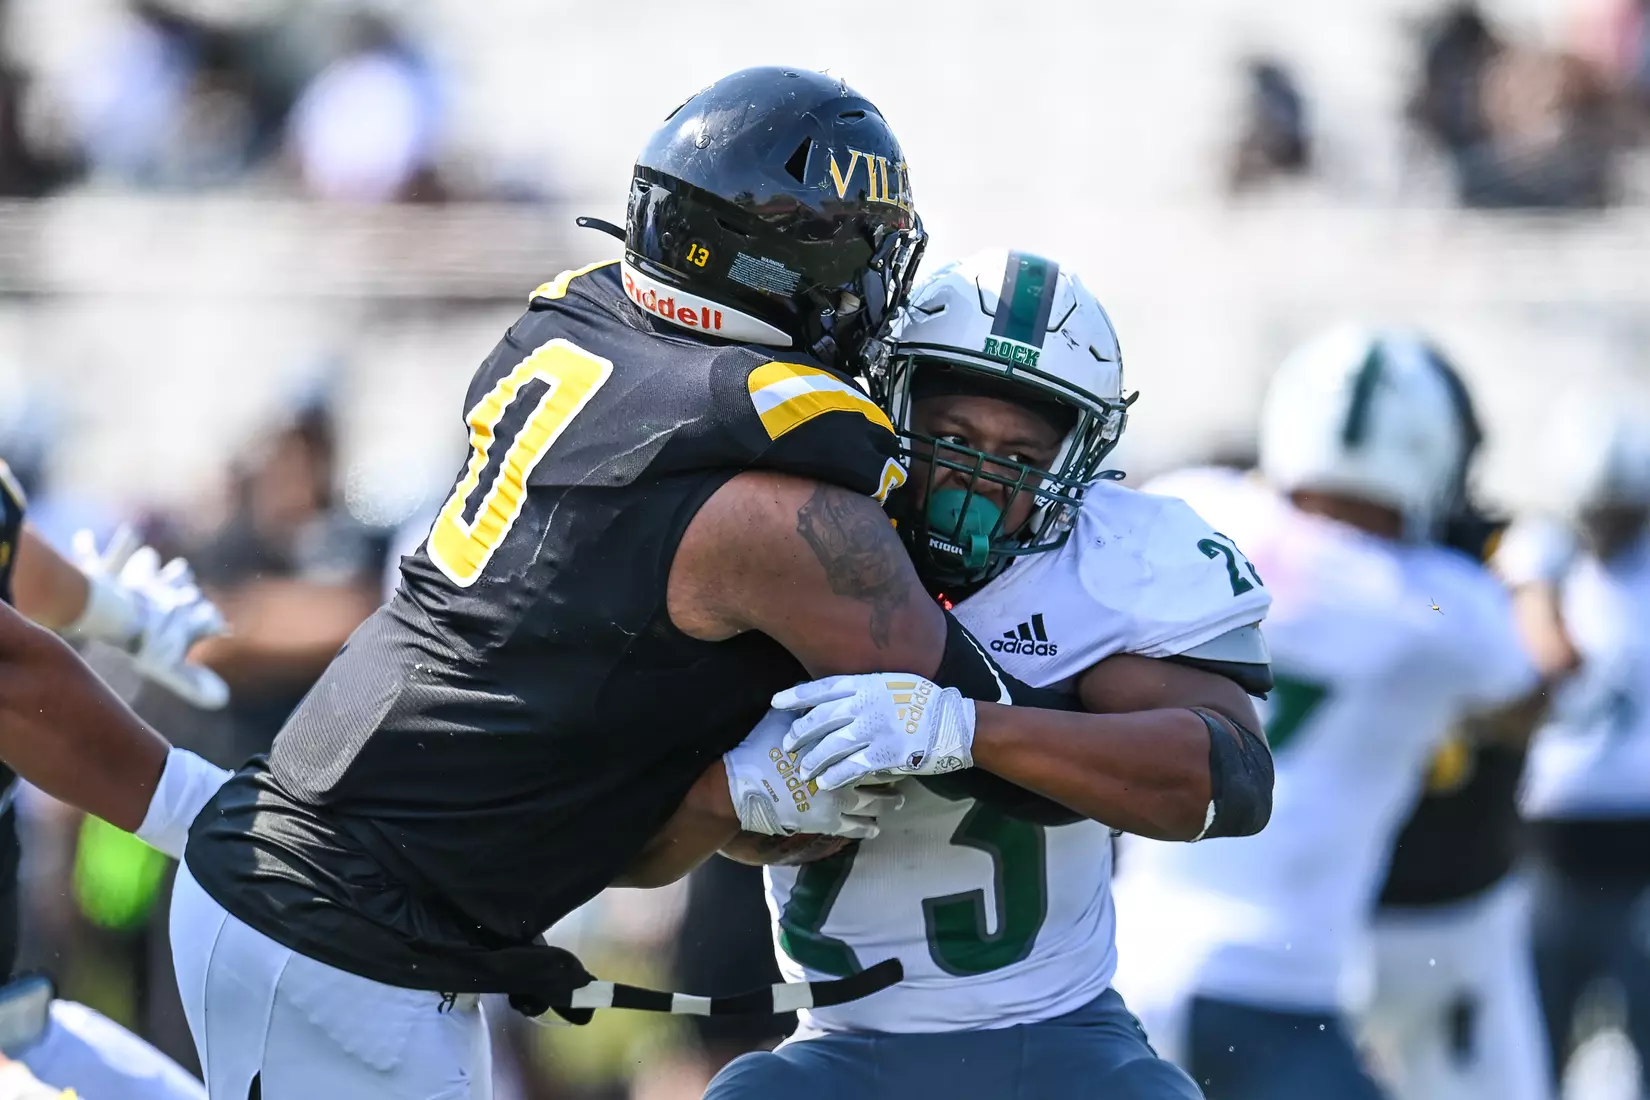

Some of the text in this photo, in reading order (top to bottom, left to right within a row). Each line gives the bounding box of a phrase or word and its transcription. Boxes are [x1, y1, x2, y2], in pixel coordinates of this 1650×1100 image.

[686, 243, 710, 267] 13
[625, 272, 722, 330] Riddell
[983, 337, 1041, 367] ROCK
[990, 639, 1058, 656] adidas
[905, 680, 934, 734] adidas
[768, 746, 811, 813] adidas
